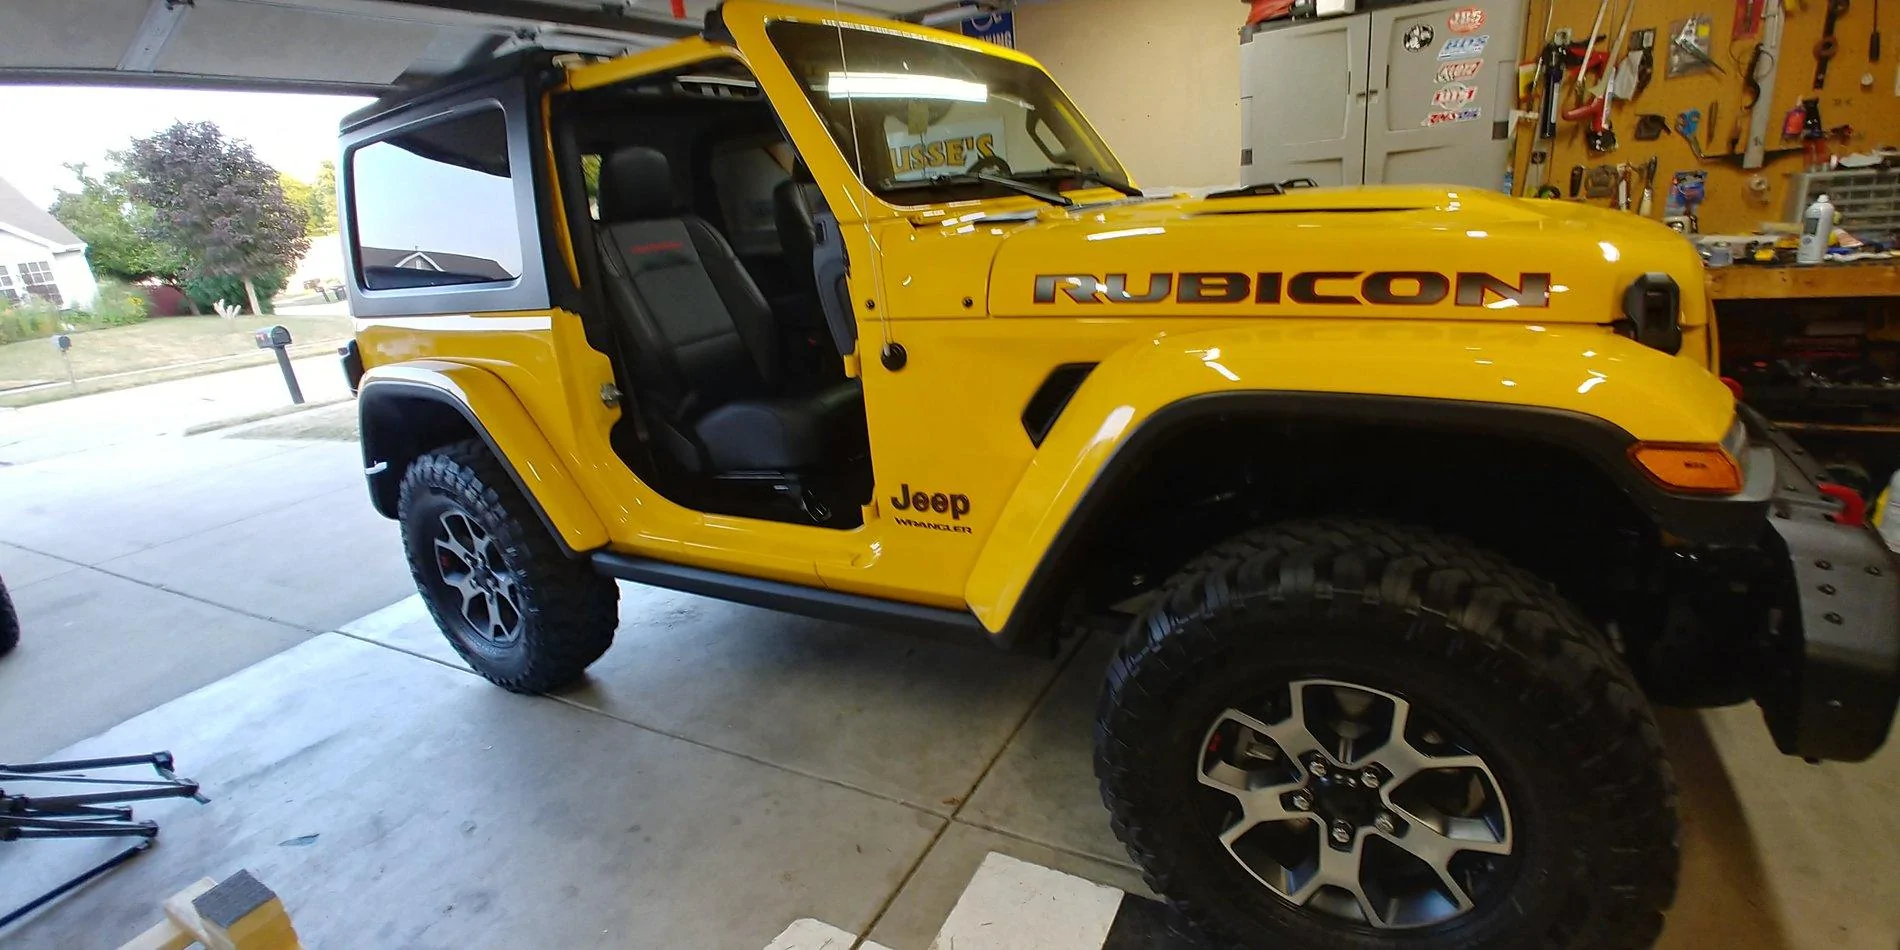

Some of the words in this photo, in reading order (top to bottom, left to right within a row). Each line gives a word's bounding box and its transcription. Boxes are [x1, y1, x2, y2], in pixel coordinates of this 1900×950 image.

[1033, 271, 1551, 308] RUBICON
[891, 483, 970, 520] Jeep
[894, 516, 972, 534] WRANGLER
